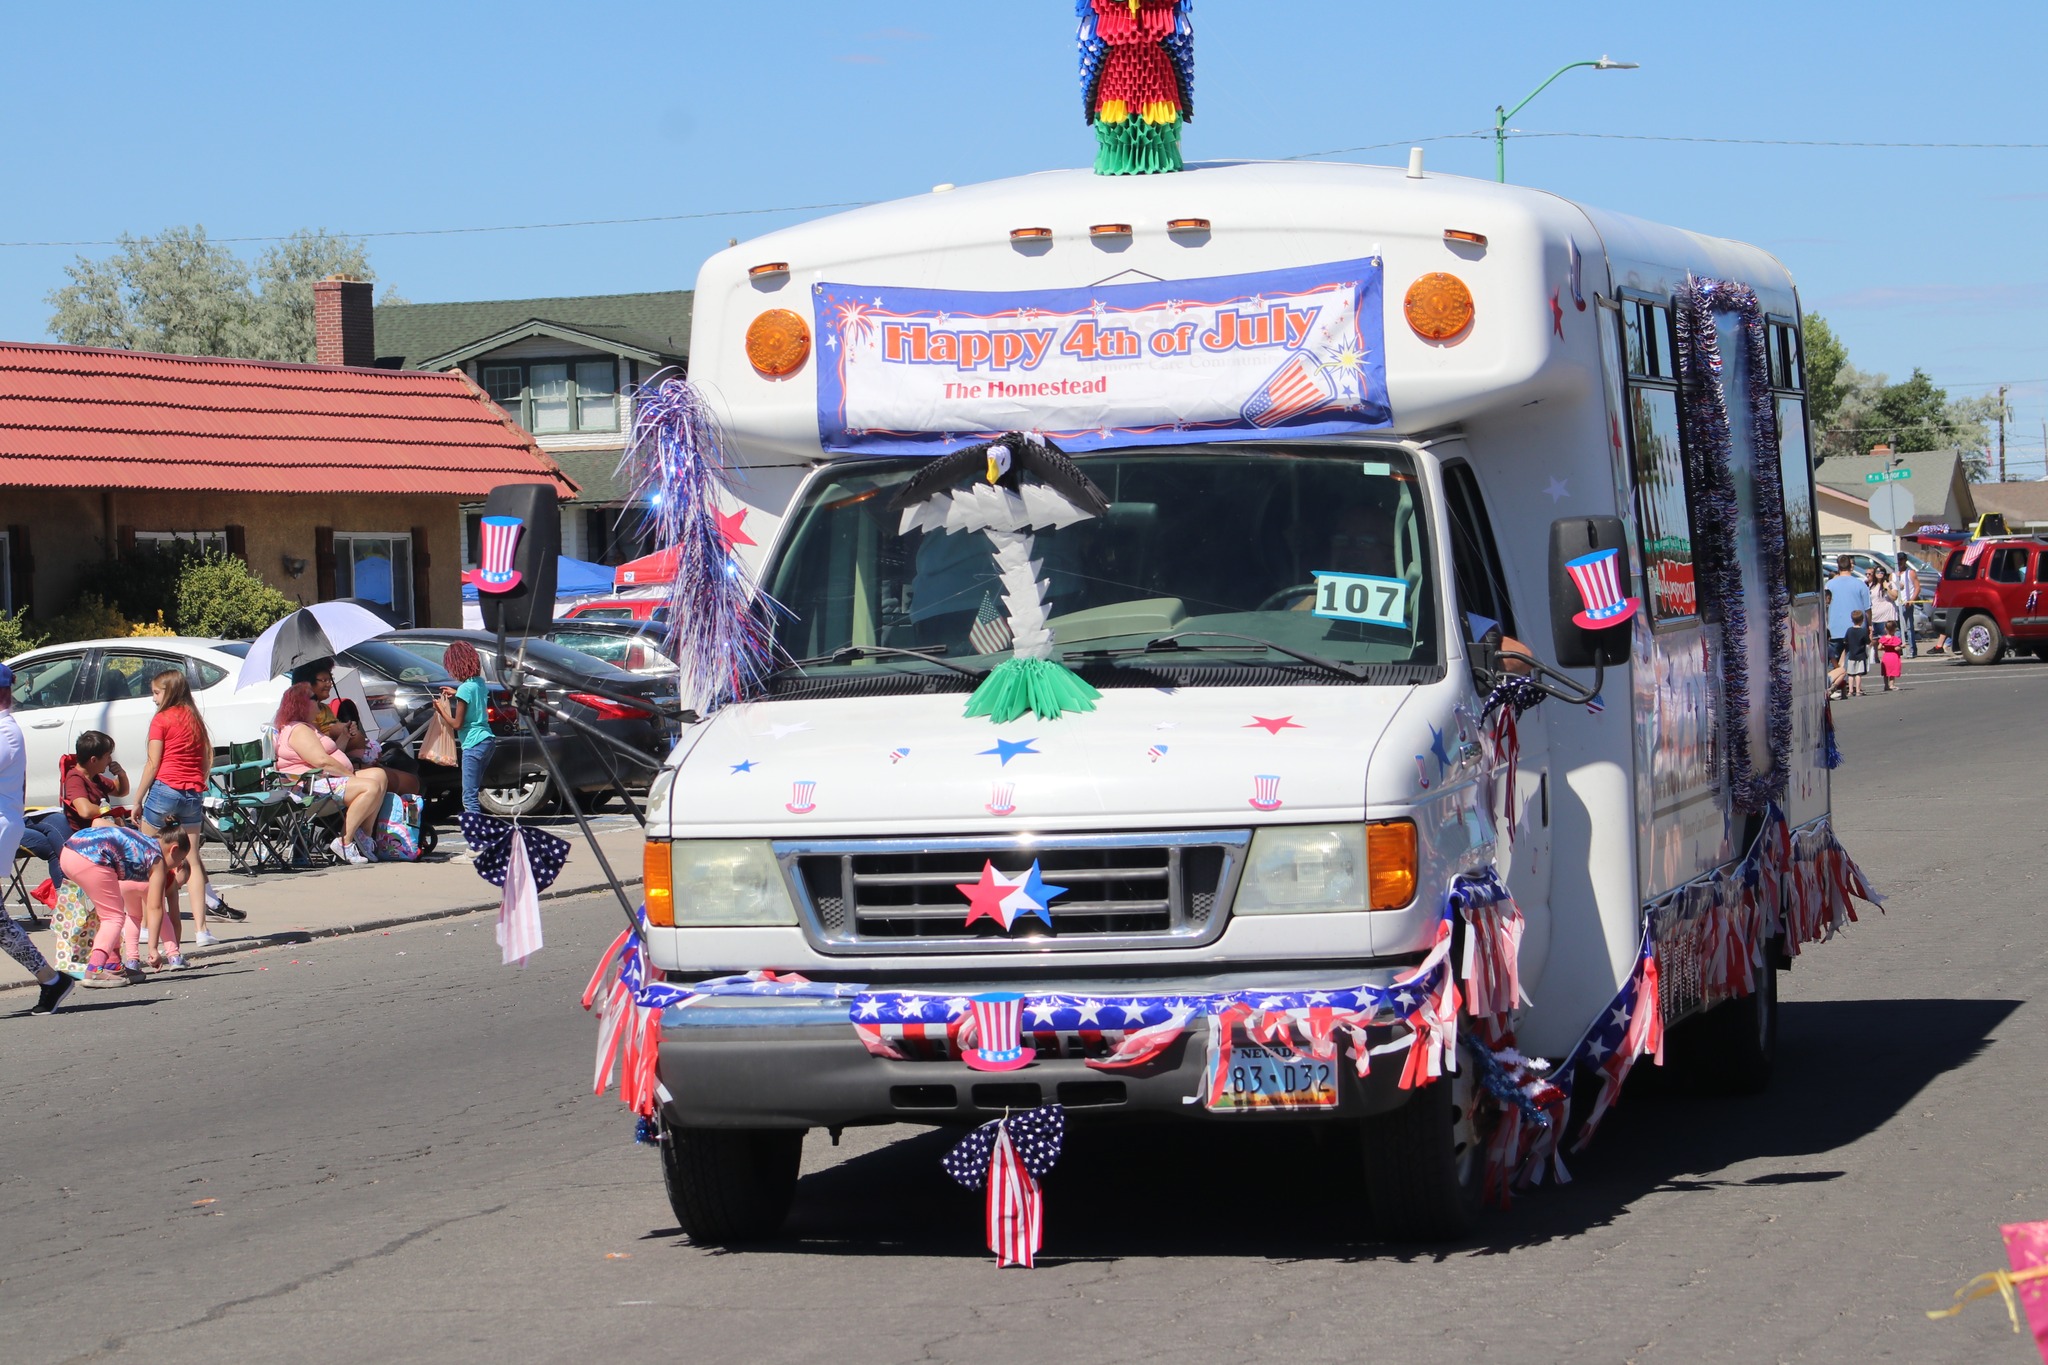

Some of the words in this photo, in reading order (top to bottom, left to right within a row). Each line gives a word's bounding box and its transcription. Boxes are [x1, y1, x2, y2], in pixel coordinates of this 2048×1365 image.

[882, 322, 1056, 371] Happy
[1061, 319, 1141, 361] 4th
[1148, 322, 1198, 357] of
[1201, 303, 1322, 352] July
[943, 383, 981, 399] The
[987, 376, 1107, 398] Homestead
[1322, 581, 1399, 617] 107
[1241, 1047, 1299, 1059] NEVAD
